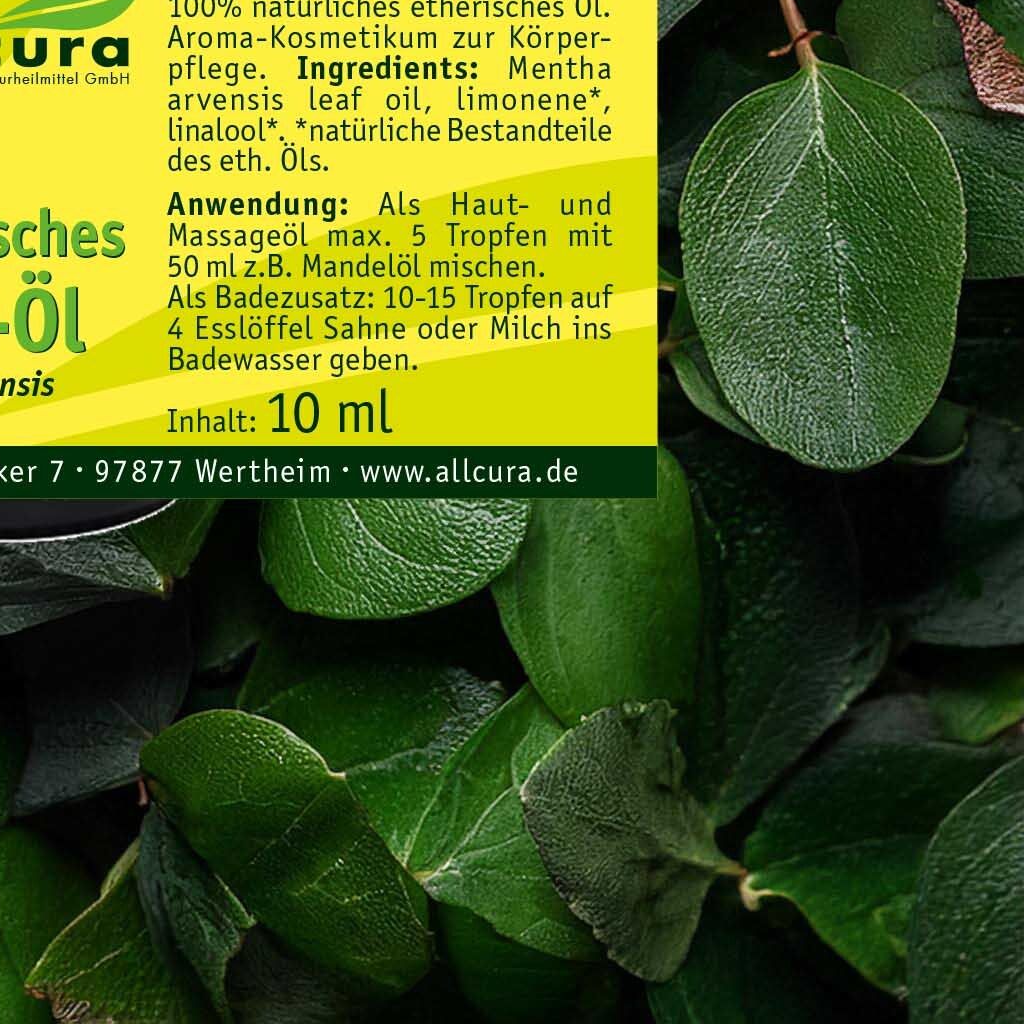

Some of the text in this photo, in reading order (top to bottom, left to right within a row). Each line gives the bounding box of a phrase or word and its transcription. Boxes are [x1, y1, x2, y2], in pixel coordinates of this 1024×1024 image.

[168, 24, 610, 54] Aroma-Kosmetikum zur Körper-
[85, 72, 129, 84] GmbH
[169, 55, 610, 85] pflege. Ingredients: Mentha
[168, 86, 283, 110] arvensis
[310, 86, 362, 110] leaf
[386, 86, 430, 114] oil,
[449, 117, 611, 141] Bestandteile
[168, 144, 328, 171] des eth. Öls.
[167, 191, 610, 221] Anwendung: Als Haut- und
[169, 221, 612, 253] Massageöl max. 5 Tropfen mit
[169, 253, 544, 277] 50 ml z.B. Mandelöl mischen.
[168, 284, 613, 315] Als Badezusatz: 10-15 Tropfen auf
[168, 313, 611, 339] 4 Esslöffel Sahne oder Milch ins
[170, 346, 417, 377] Badewasser geben.
[168, 388, 393, 433] Inhalt: 10 ml
[51, 461, 63, 482] 7
[96, 460, 181, 482] 97877
[196, 458, 329, 482] Wertheim
[361, 458, 577, 482] www.allcura.de
